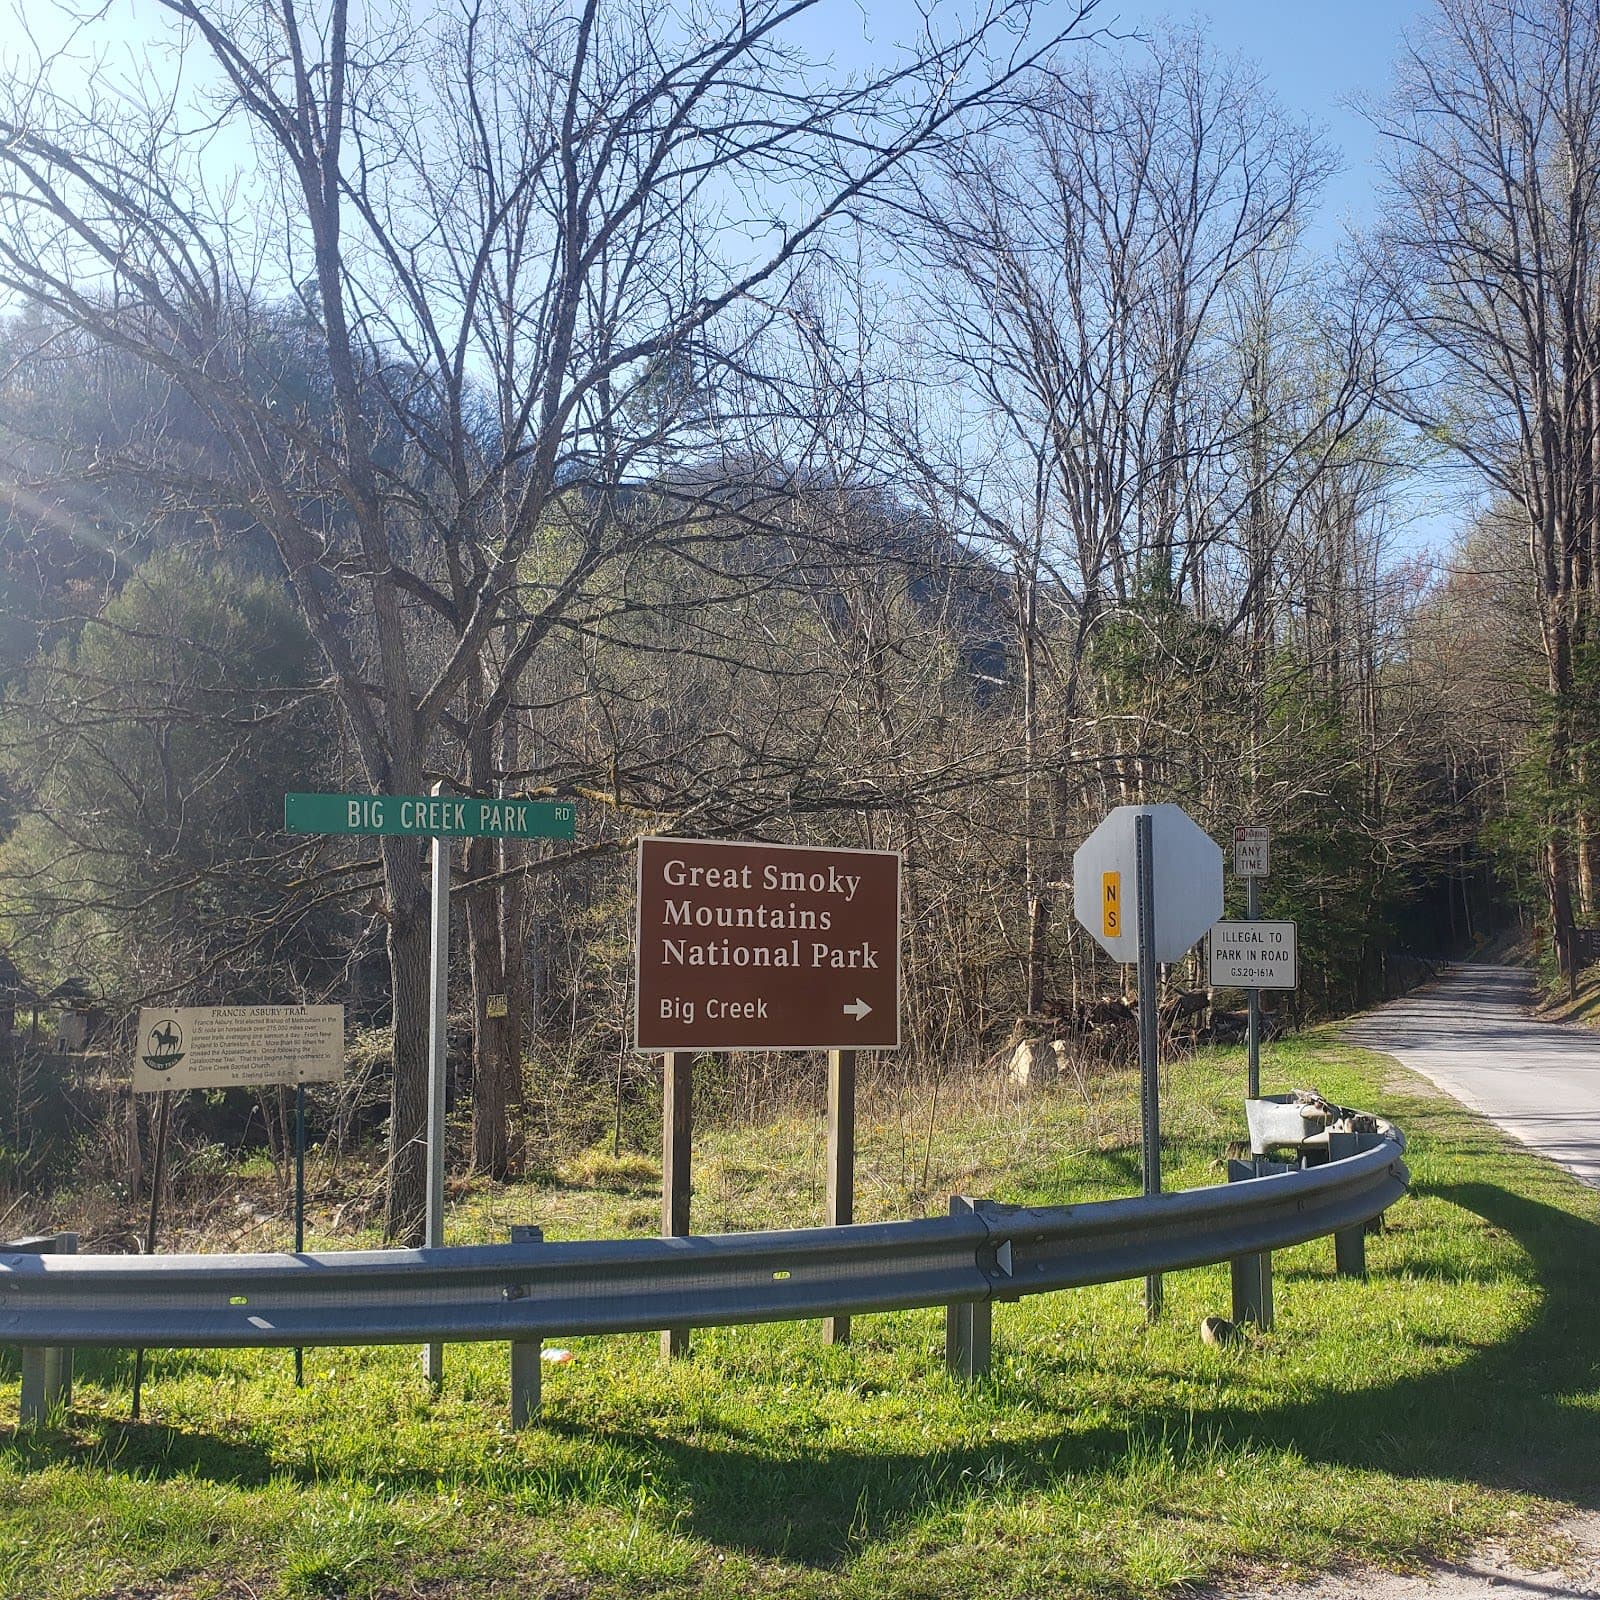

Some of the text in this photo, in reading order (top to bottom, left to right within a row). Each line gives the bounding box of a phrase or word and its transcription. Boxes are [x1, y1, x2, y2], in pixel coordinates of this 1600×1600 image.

[347, 800, 571, 832] BIG CREEK PARK RD
[1241, 846, 1261, 857] ANY
[1241, 860, 1262, 870] TIME
[663, 860, 861, 901] Great Smoky
[1107, 885, 1116, 901] N
[662, 899, 832, 930] Mountains
[1108, 911, 1116, 928] S
[1222, 931, 1282, 943] ILLEGAL TO
[661, 938, 878, 969] National Park
[1216, 949, 1289, 961] PARK IN ROAD
[211, 1006, 308, 1018] FRANCIS ASBURY TRAIL
[660, 997, 768, 1024] Big Creek
